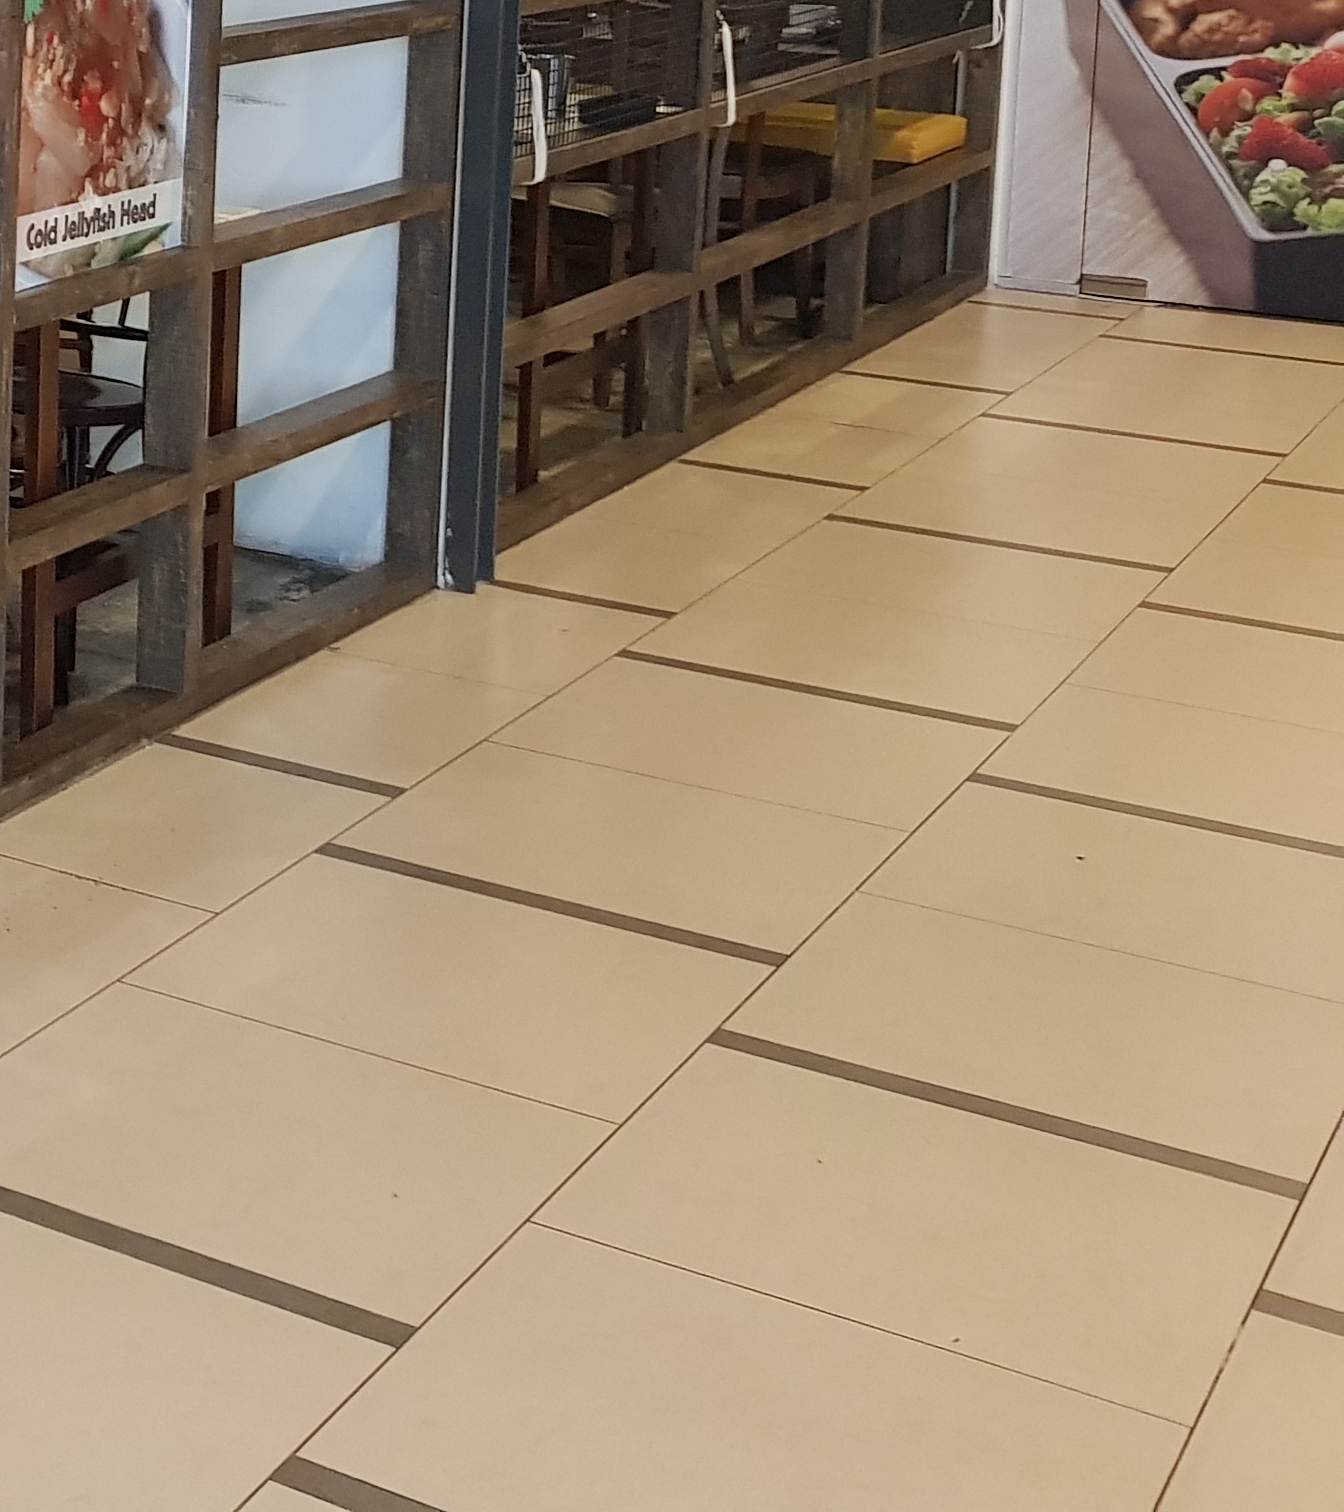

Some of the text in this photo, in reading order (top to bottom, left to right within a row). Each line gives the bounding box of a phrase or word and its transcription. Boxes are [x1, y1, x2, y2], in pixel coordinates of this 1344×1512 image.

[26, 192, 158, 251] Cold Jellyfish Head
